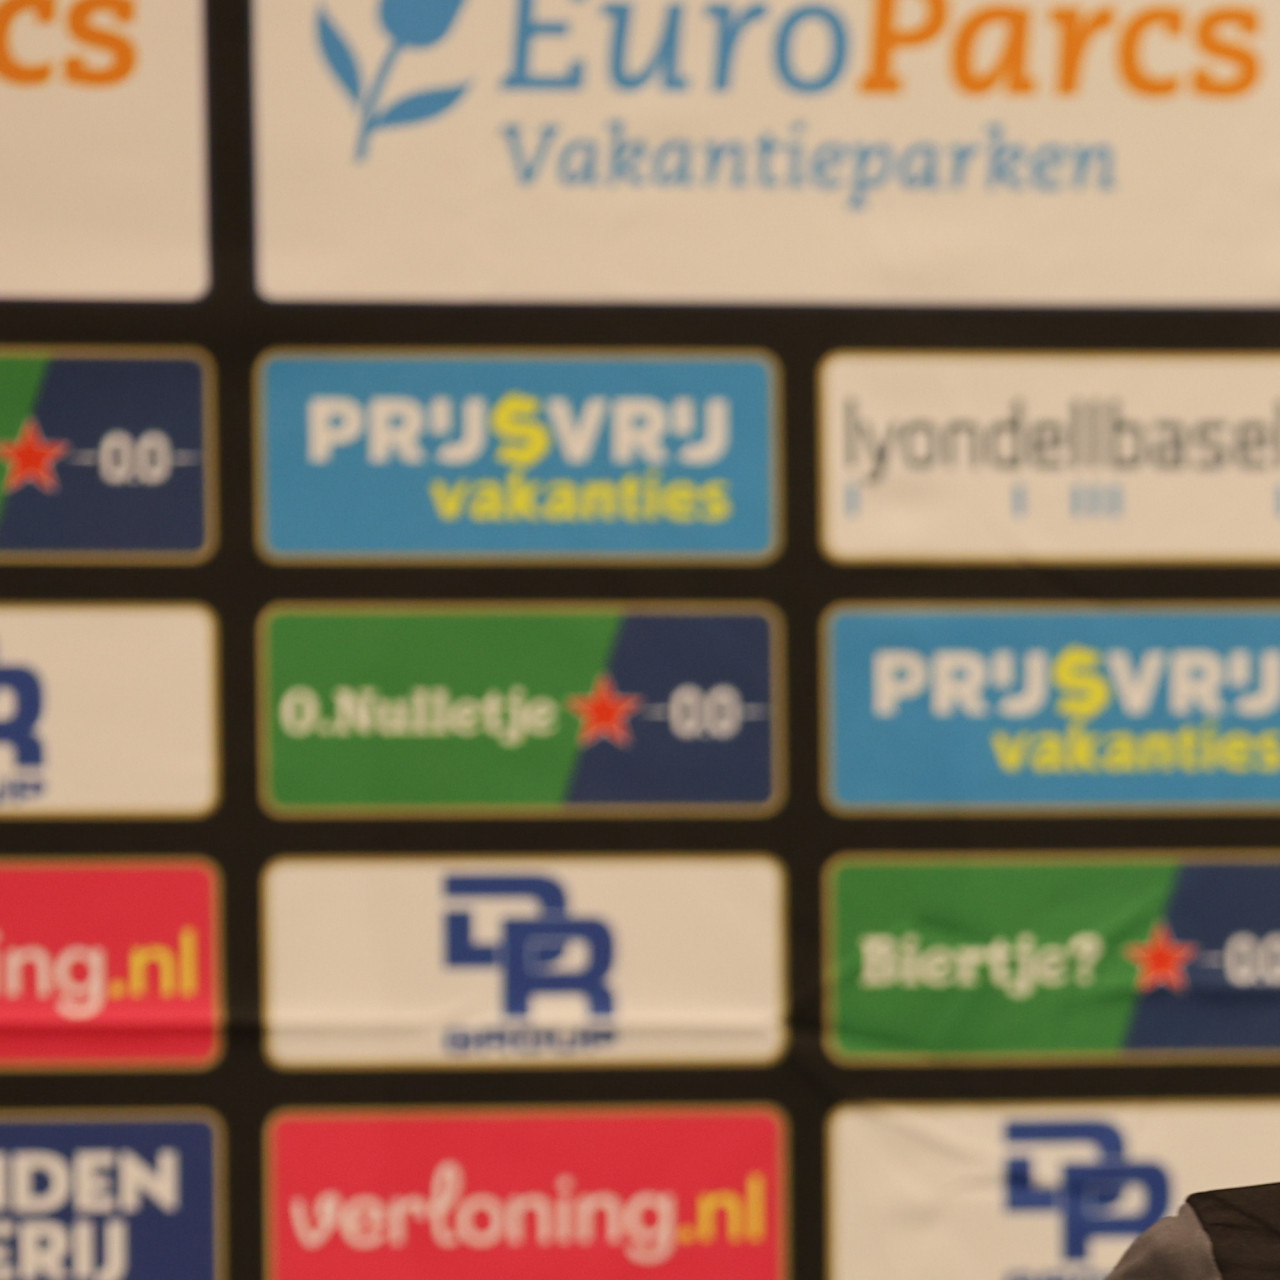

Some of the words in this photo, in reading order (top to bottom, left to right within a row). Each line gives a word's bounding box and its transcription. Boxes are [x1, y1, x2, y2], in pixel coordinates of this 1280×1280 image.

[500, 0, 1262, 97] EuroParcs
[500, 122, 1117, 208] Vakantieparken
[428, 472, 734, 524] vakanties
[858, 932, 1105, 1000] Biertje?
[289, 1160, 768, 1268] verloning.nl
